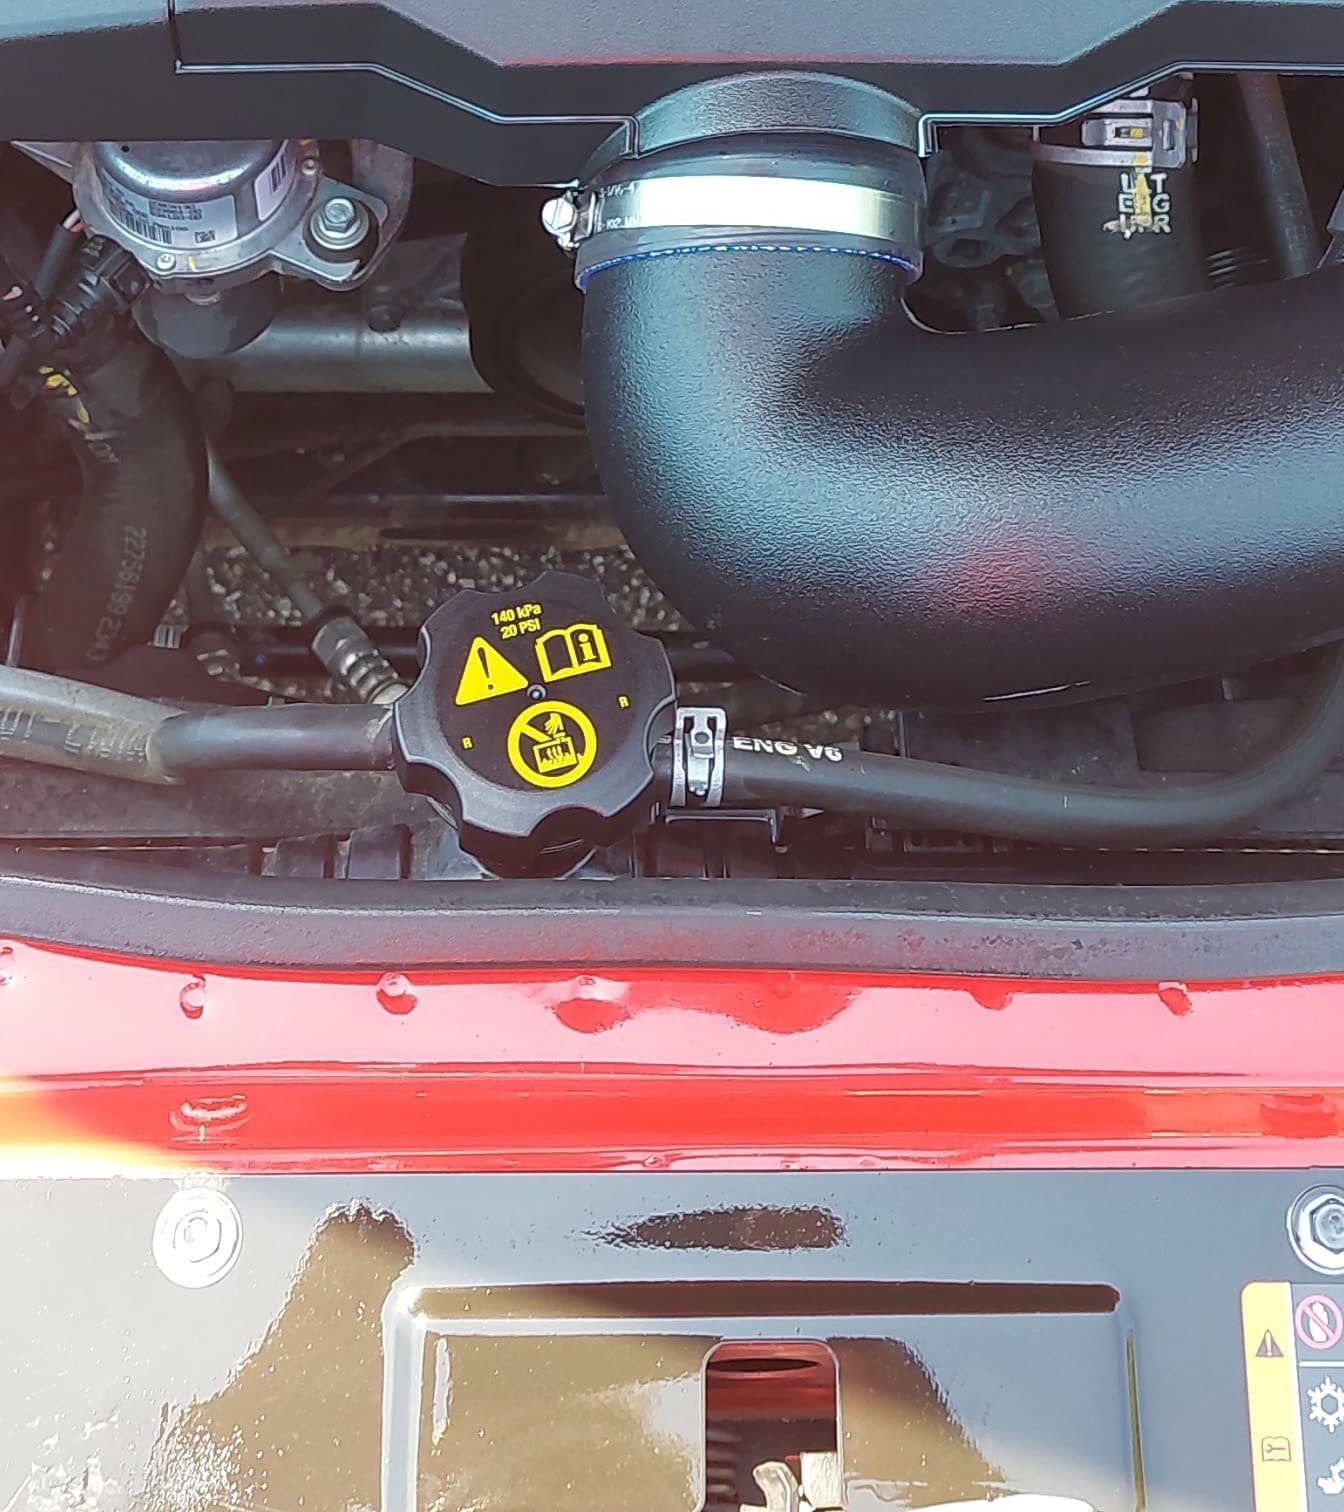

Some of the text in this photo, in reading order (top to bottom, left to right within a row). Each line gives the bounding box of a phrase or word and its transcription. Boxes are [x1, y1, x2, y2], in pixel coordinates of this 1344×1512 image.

[1118, 194, 1171, 213] EG
[491, 602, 542, 626] 140 kPa
[500, 619, 542, 640] 20 PSI
[731, 736, 798, 756] ENG
